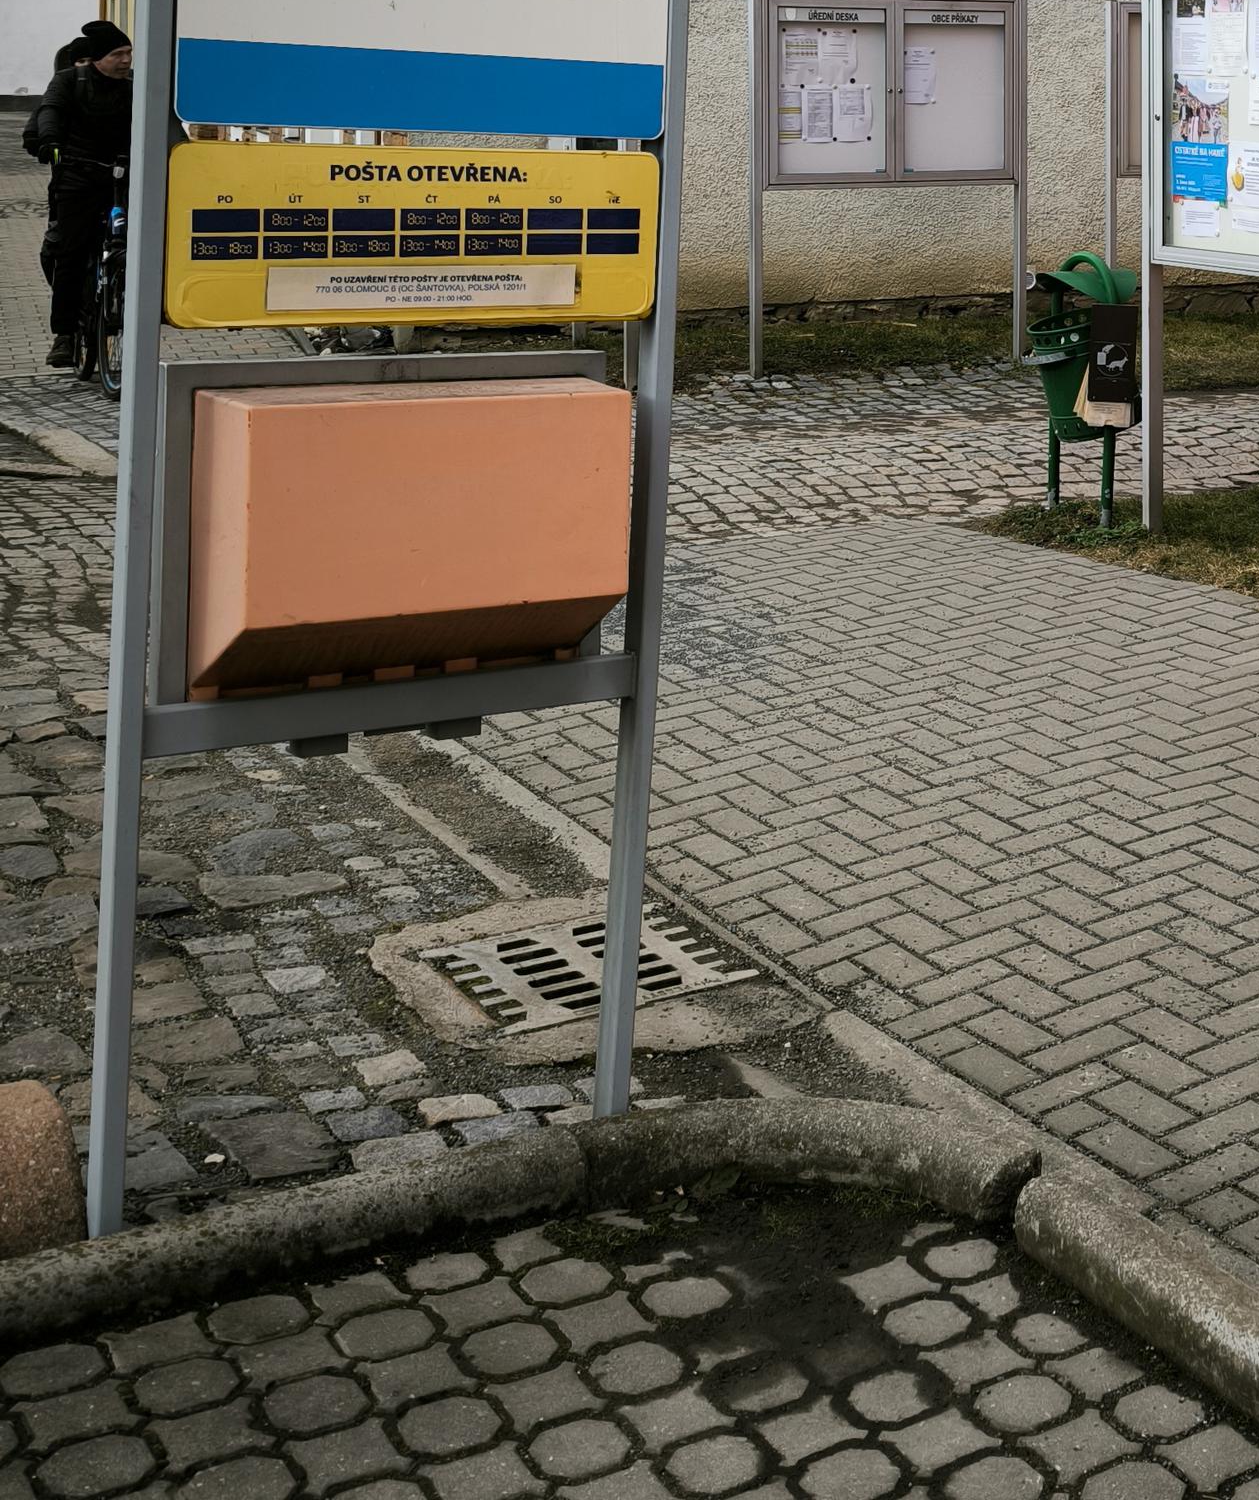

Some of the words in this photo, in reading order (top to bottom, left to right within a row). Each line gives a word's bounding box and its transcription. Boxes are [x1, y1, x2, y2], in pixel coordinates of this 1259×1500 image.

[808, 9, 834, 21] ÚŘEDNÍ
[836, 12, 859, 21] DESKA
[931, 14, 949, 23] OBCE
[329, 161, 402, 183] POŠTA
[406, 162, 528, 183] OTEVŘENA:
[217, 195, 233, 204] PO
[357, 195, 371, 204] ST
[549, 195, 562, 204] SO
[330, 276, 343, 284] PO
[344, 275, 387, 284] UZAVŘENÍ
[388, 274, 410, 283] TÉTO
[411, 274, 438, 283] POŠTY
[440, 275, 449, 283] JE
[450, 274, 493, 283] OTEVŘENA
[315, 285, 331, 293] 770
[332, 285, 343, 293] 06
[344, 285, 389, 293] OLOMOUC
[398, 284, 414, 294] (OC
[467, 283, 500, 292] POLSKÁ
